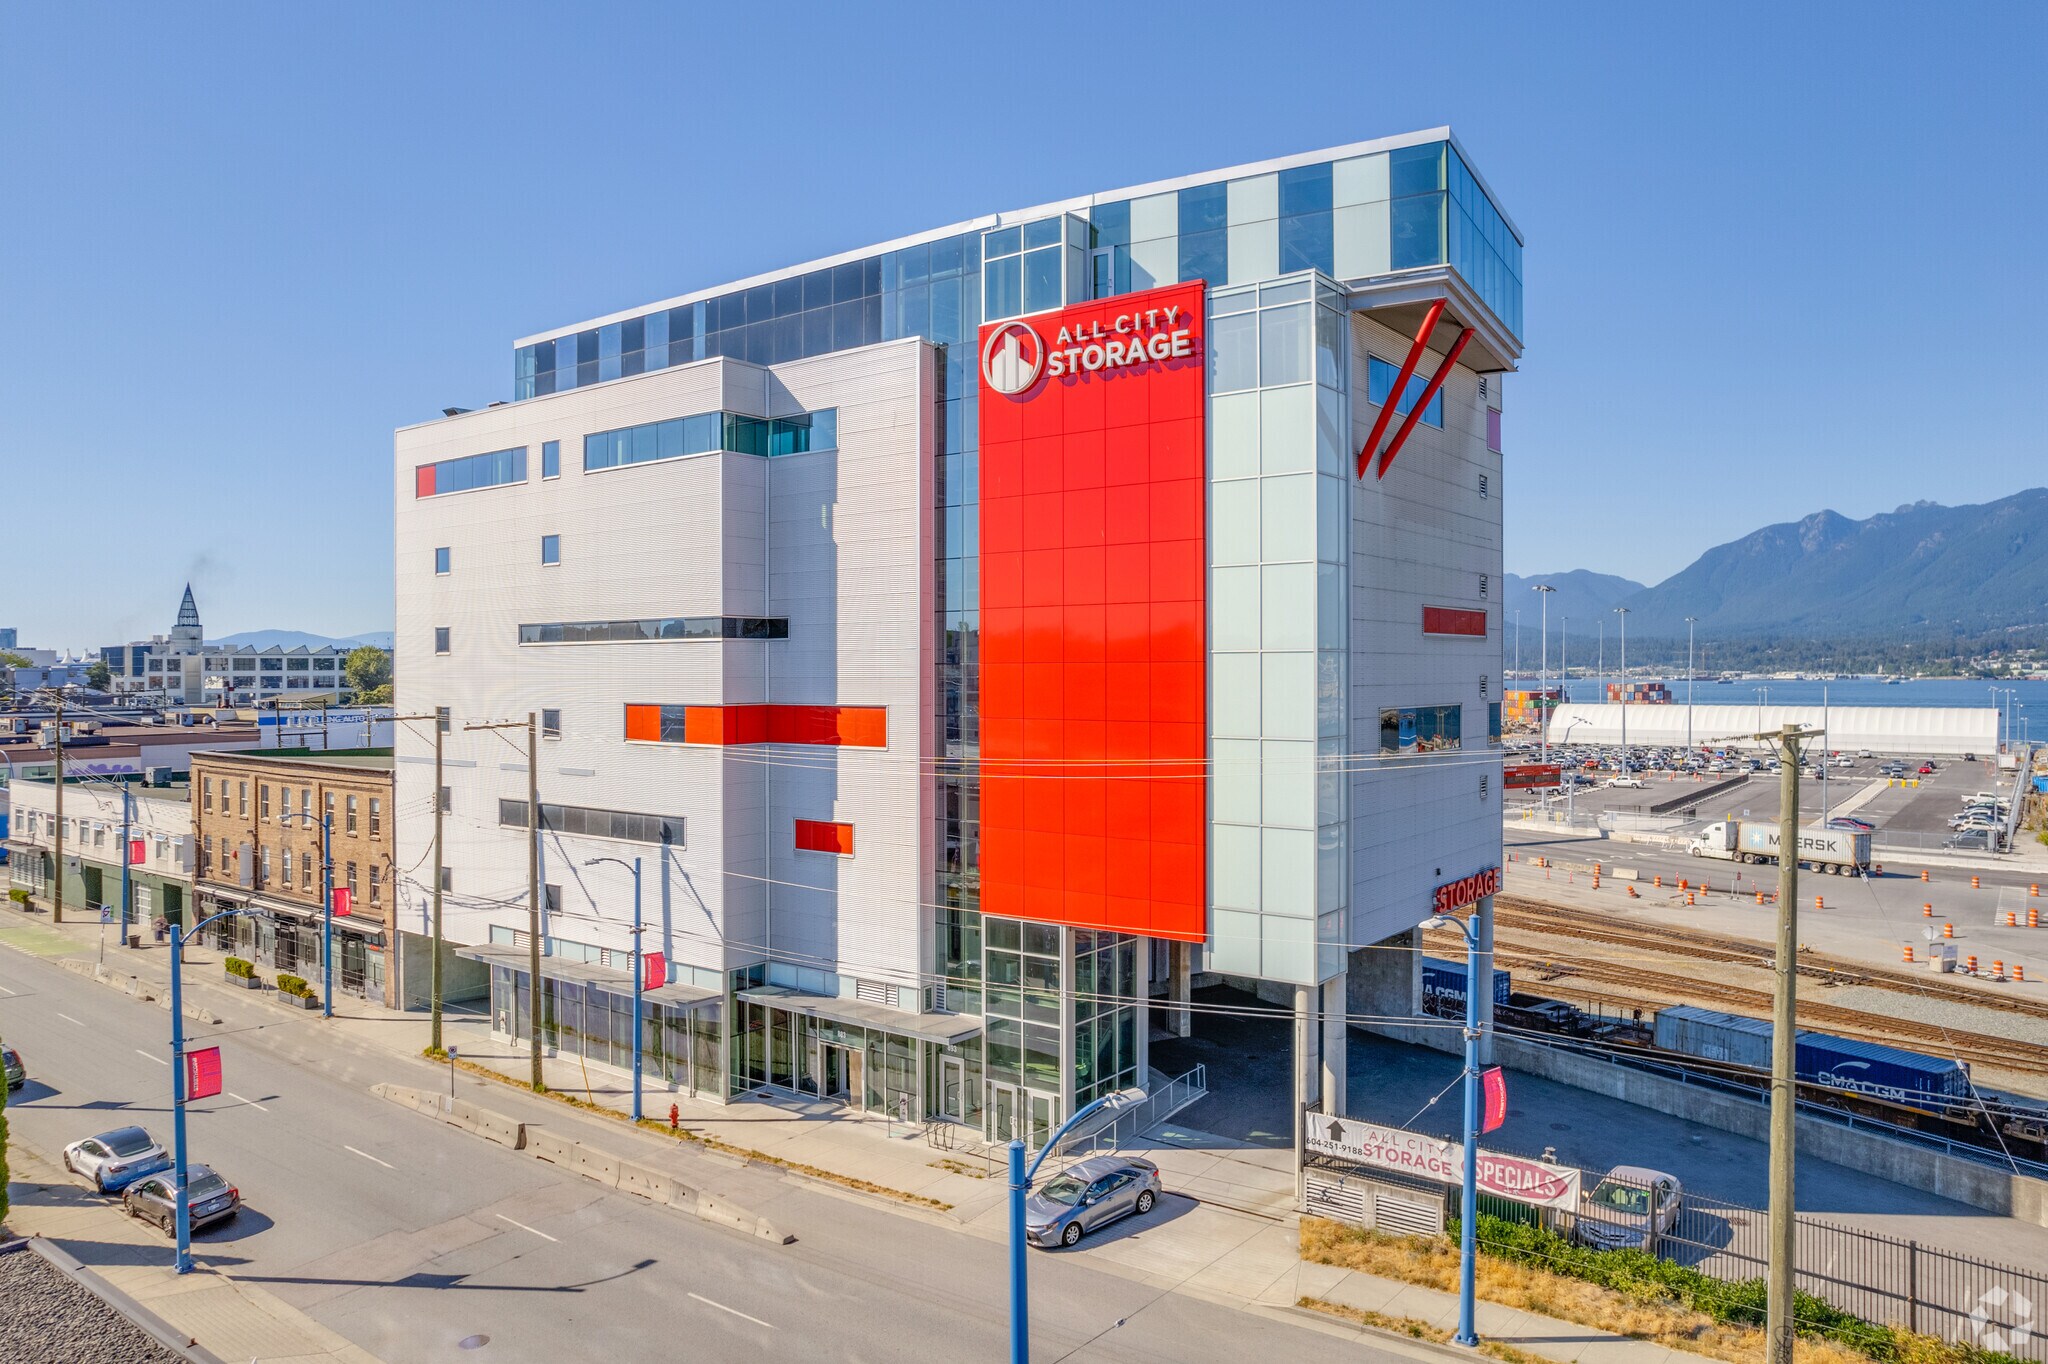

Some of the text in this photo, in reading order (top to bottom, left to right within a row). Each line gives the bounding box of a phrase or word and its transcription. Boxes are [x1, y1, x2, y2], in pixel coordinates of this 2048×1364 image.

[1056, 305, 1179, 345] ALL CITY
[1048, 329, 1192, 377] STORAGE
[1769, 834, 1837, 852] MERSK
[1436, 867, 1500, 914] STORAGE
[1435, 986, 1467, 1001] CGM
[1818, 1071, 1905, 1103] CMA CGM
[1306, 1137, 1363, 1156] 604-251-9188
[1363, 1143, 1452, 1176] STORAGE
[1369, 1131, 1447, 1156] ALL CITY
[1475, 1158, 1556, 1197] SPECIALS
